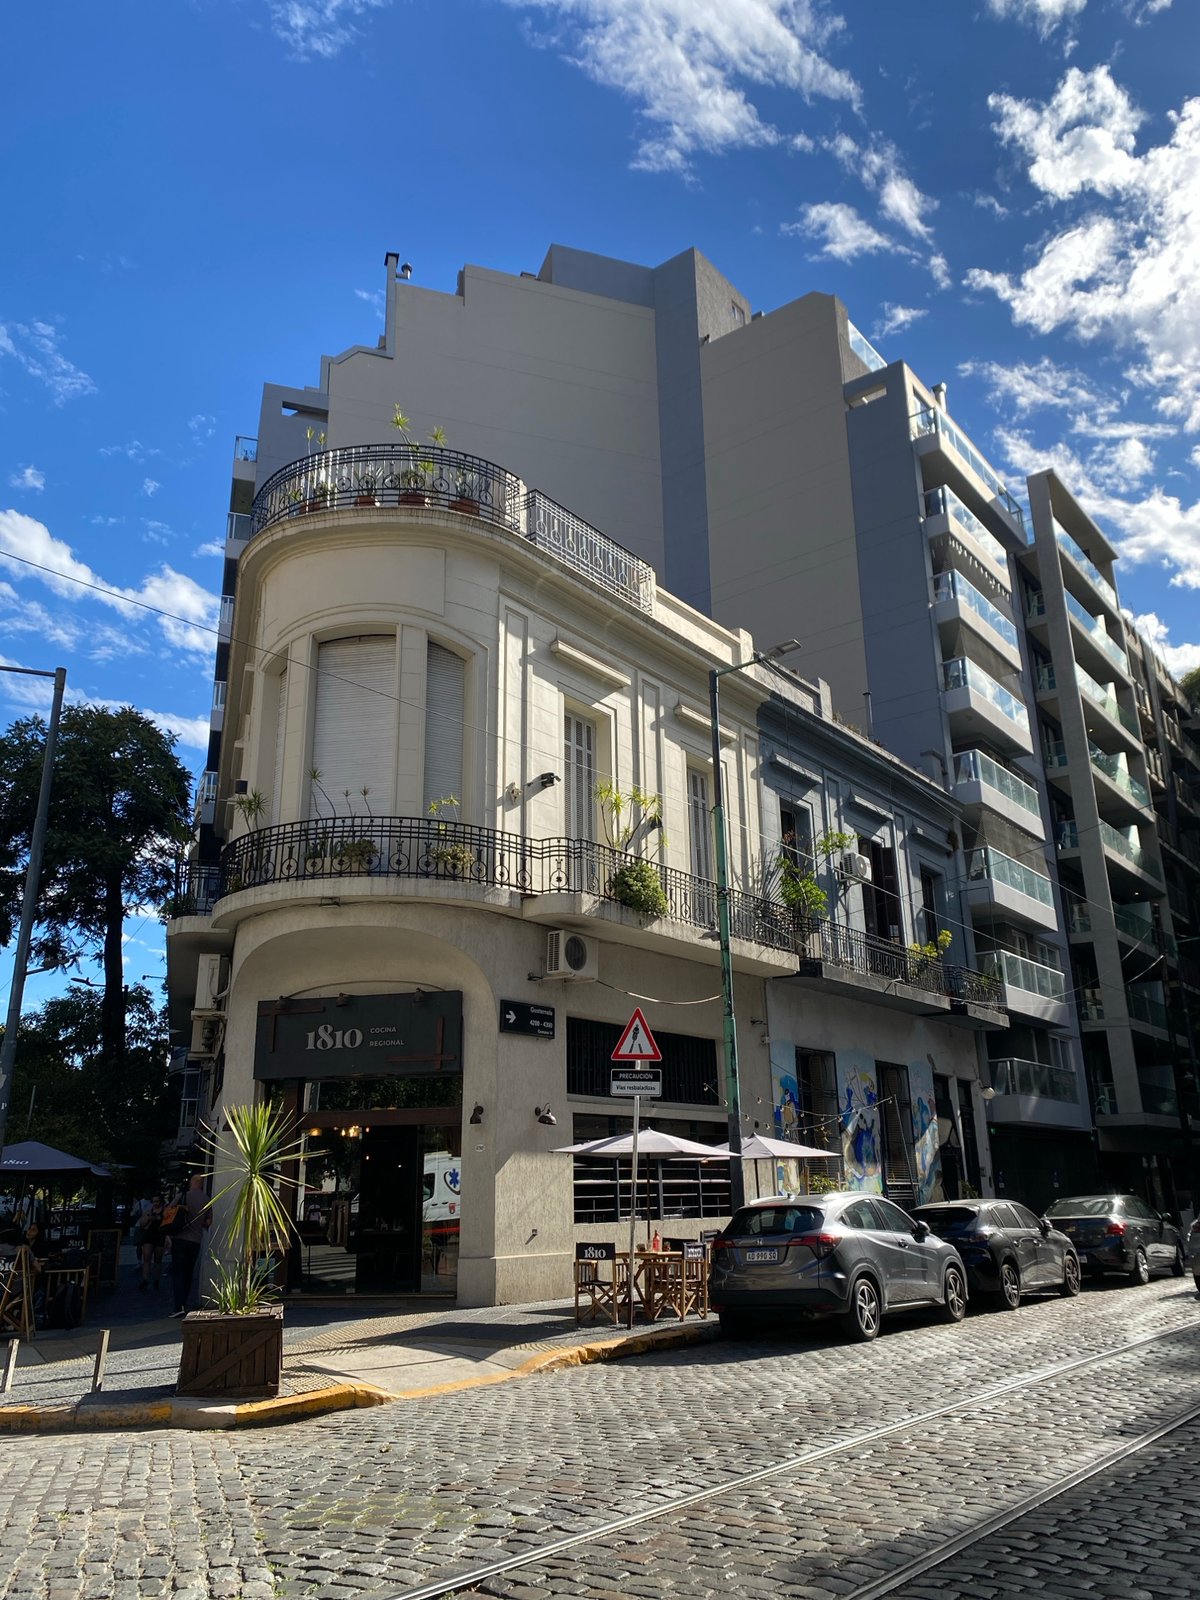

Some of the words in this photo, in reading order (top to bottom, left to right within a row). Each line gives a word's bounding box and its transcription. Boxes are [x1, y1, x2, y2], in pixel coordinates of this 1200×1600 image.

[305, 1024, 363, 1050] 1810
[370, 1026, 397, 1034] COCINA
[369, 1039, 405, 1047] REGIONAL
[50, 1213, 74, 1224] 180
[584, 1247, 606, 1258] 1810
